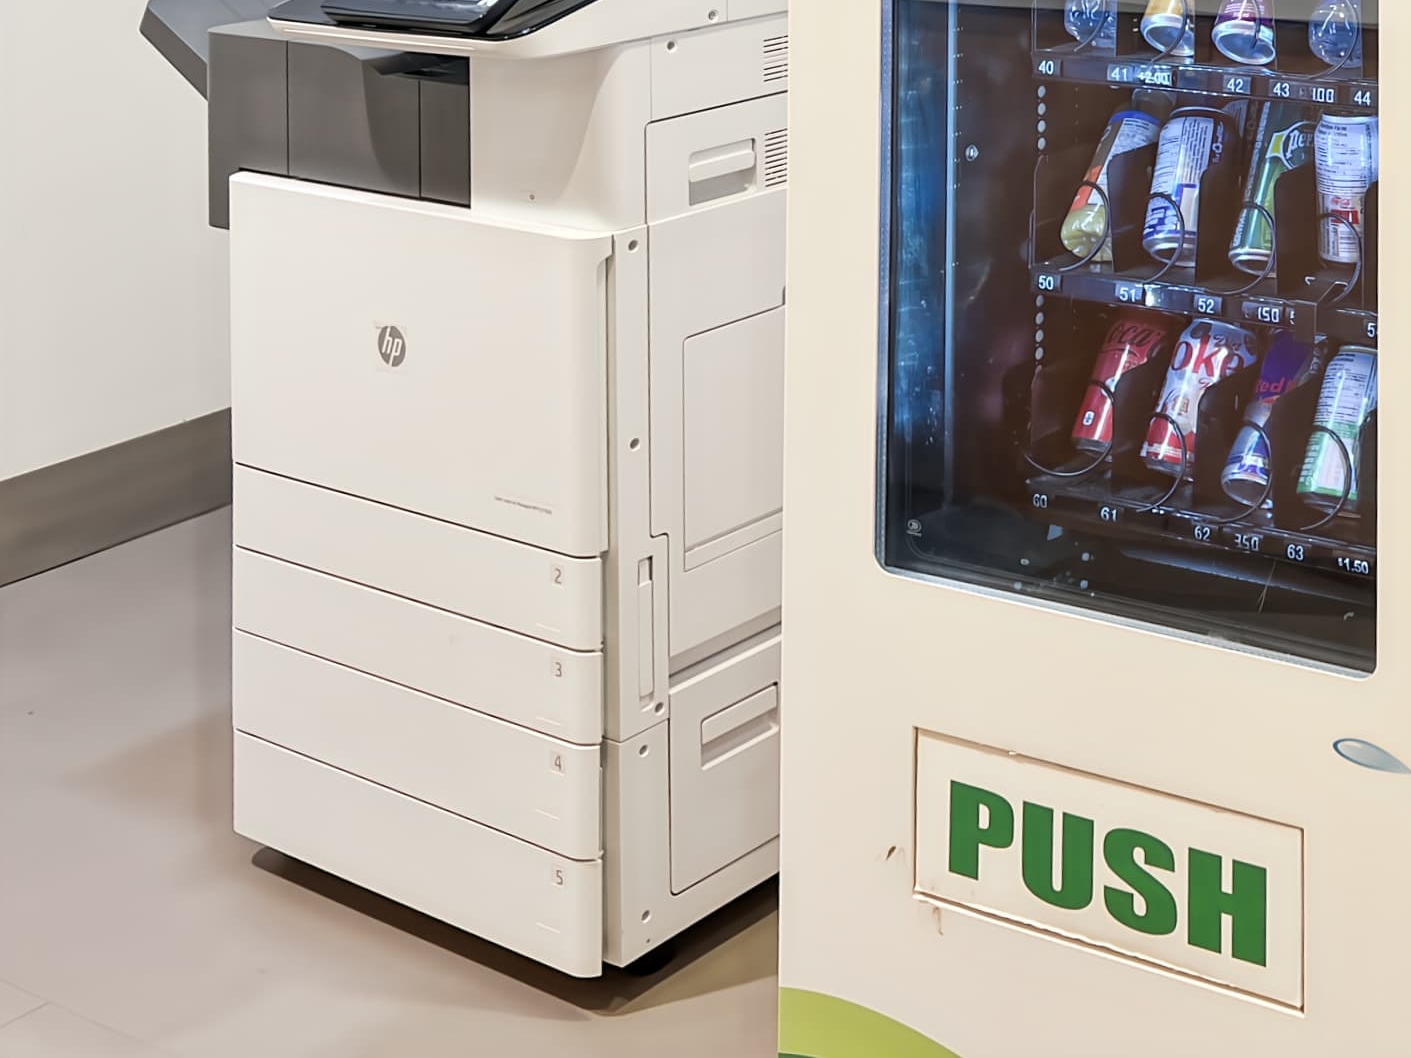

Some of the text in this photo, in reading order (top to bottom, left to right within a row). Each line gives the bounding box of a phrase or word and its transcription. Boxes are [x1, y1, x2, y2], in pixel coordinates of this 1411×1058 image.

[1038, 61, 1054, 75] 40
[1111, 67, 1128, 82] 41
[1227, 78, 1243, 92] 42
[1273, 83, 1290, 98] 43
[1353, 90, 1371, 106] 44
[1038, 275, 1054, 290] 50
[1119, 287, 1137, 302] 51
[1198, 299, 1214, 313] 52
[1367, 322, 1378, 338] 5
[379, 326, 406, 367] hp
[1033, 494, 1048, 509] 60
[1101, 508, 1118, 522] 61
[1194, 526, 1211, 541] 62
[1287, 544, 1304, 560] 63
[1337, 557, 1369, 574] $1.50
[553, 568, 562, 584] 2
[554, 662, 563, 677] 3
[554, 755, 562, 771] 4
[555, 869, 564, 885] 5
[949, 779, 1267, 968] PUSH
